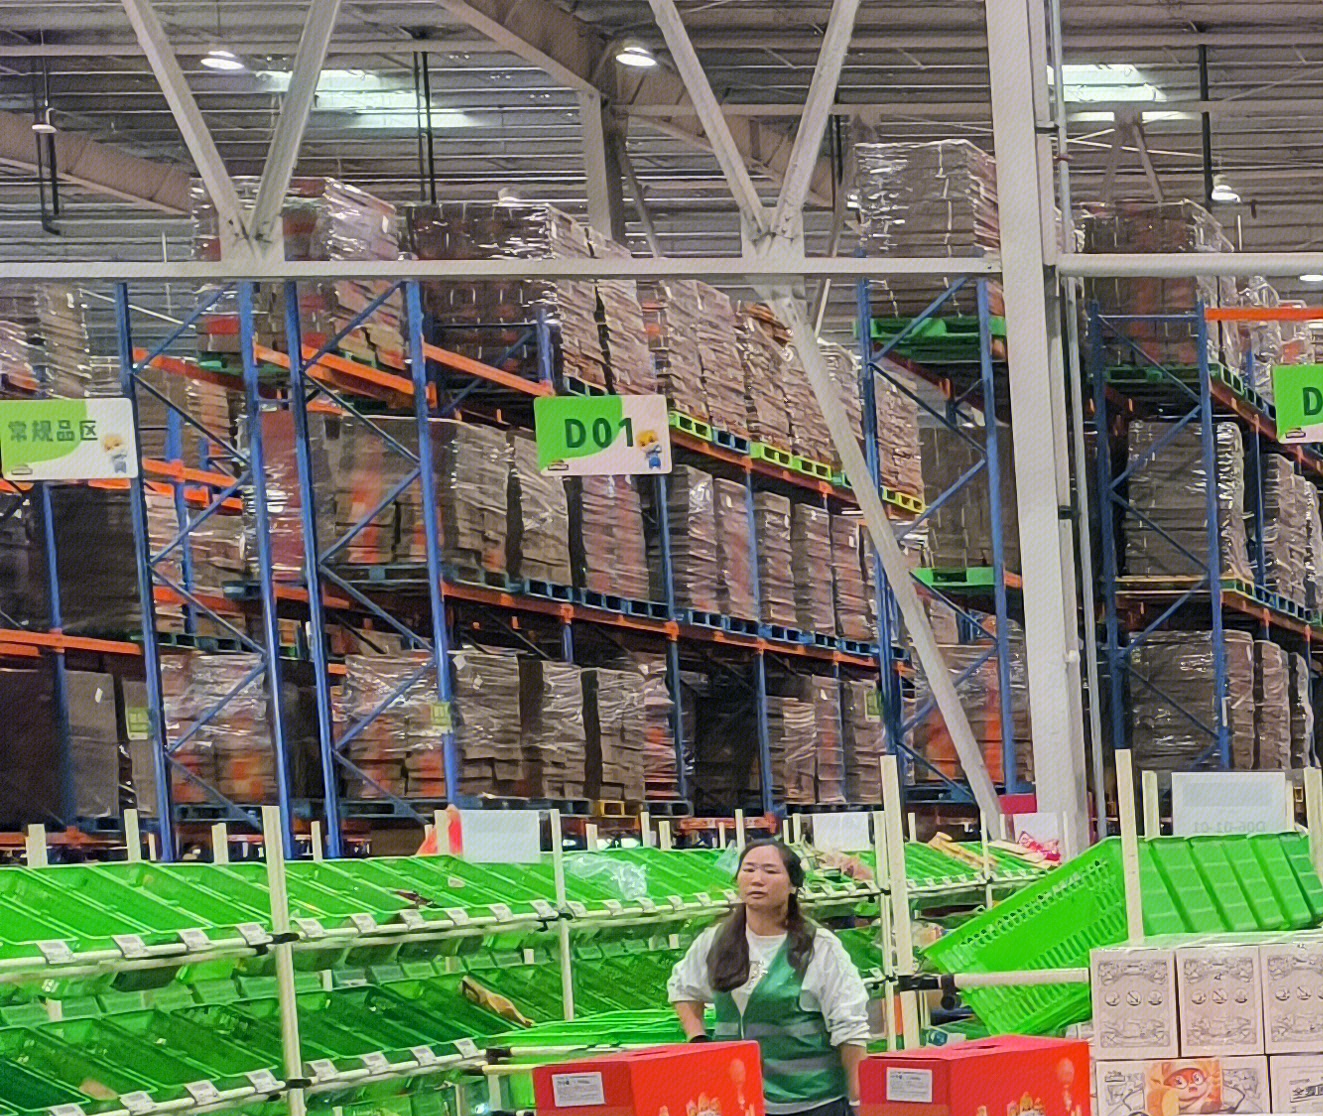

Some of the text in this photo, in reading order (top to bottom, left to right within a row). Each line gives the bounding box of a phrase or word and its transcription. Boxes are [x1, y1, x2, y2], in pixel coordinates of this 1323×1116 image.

[8, 420, 98, 442] 常规品区
[565, 418, 634, 448] D01
